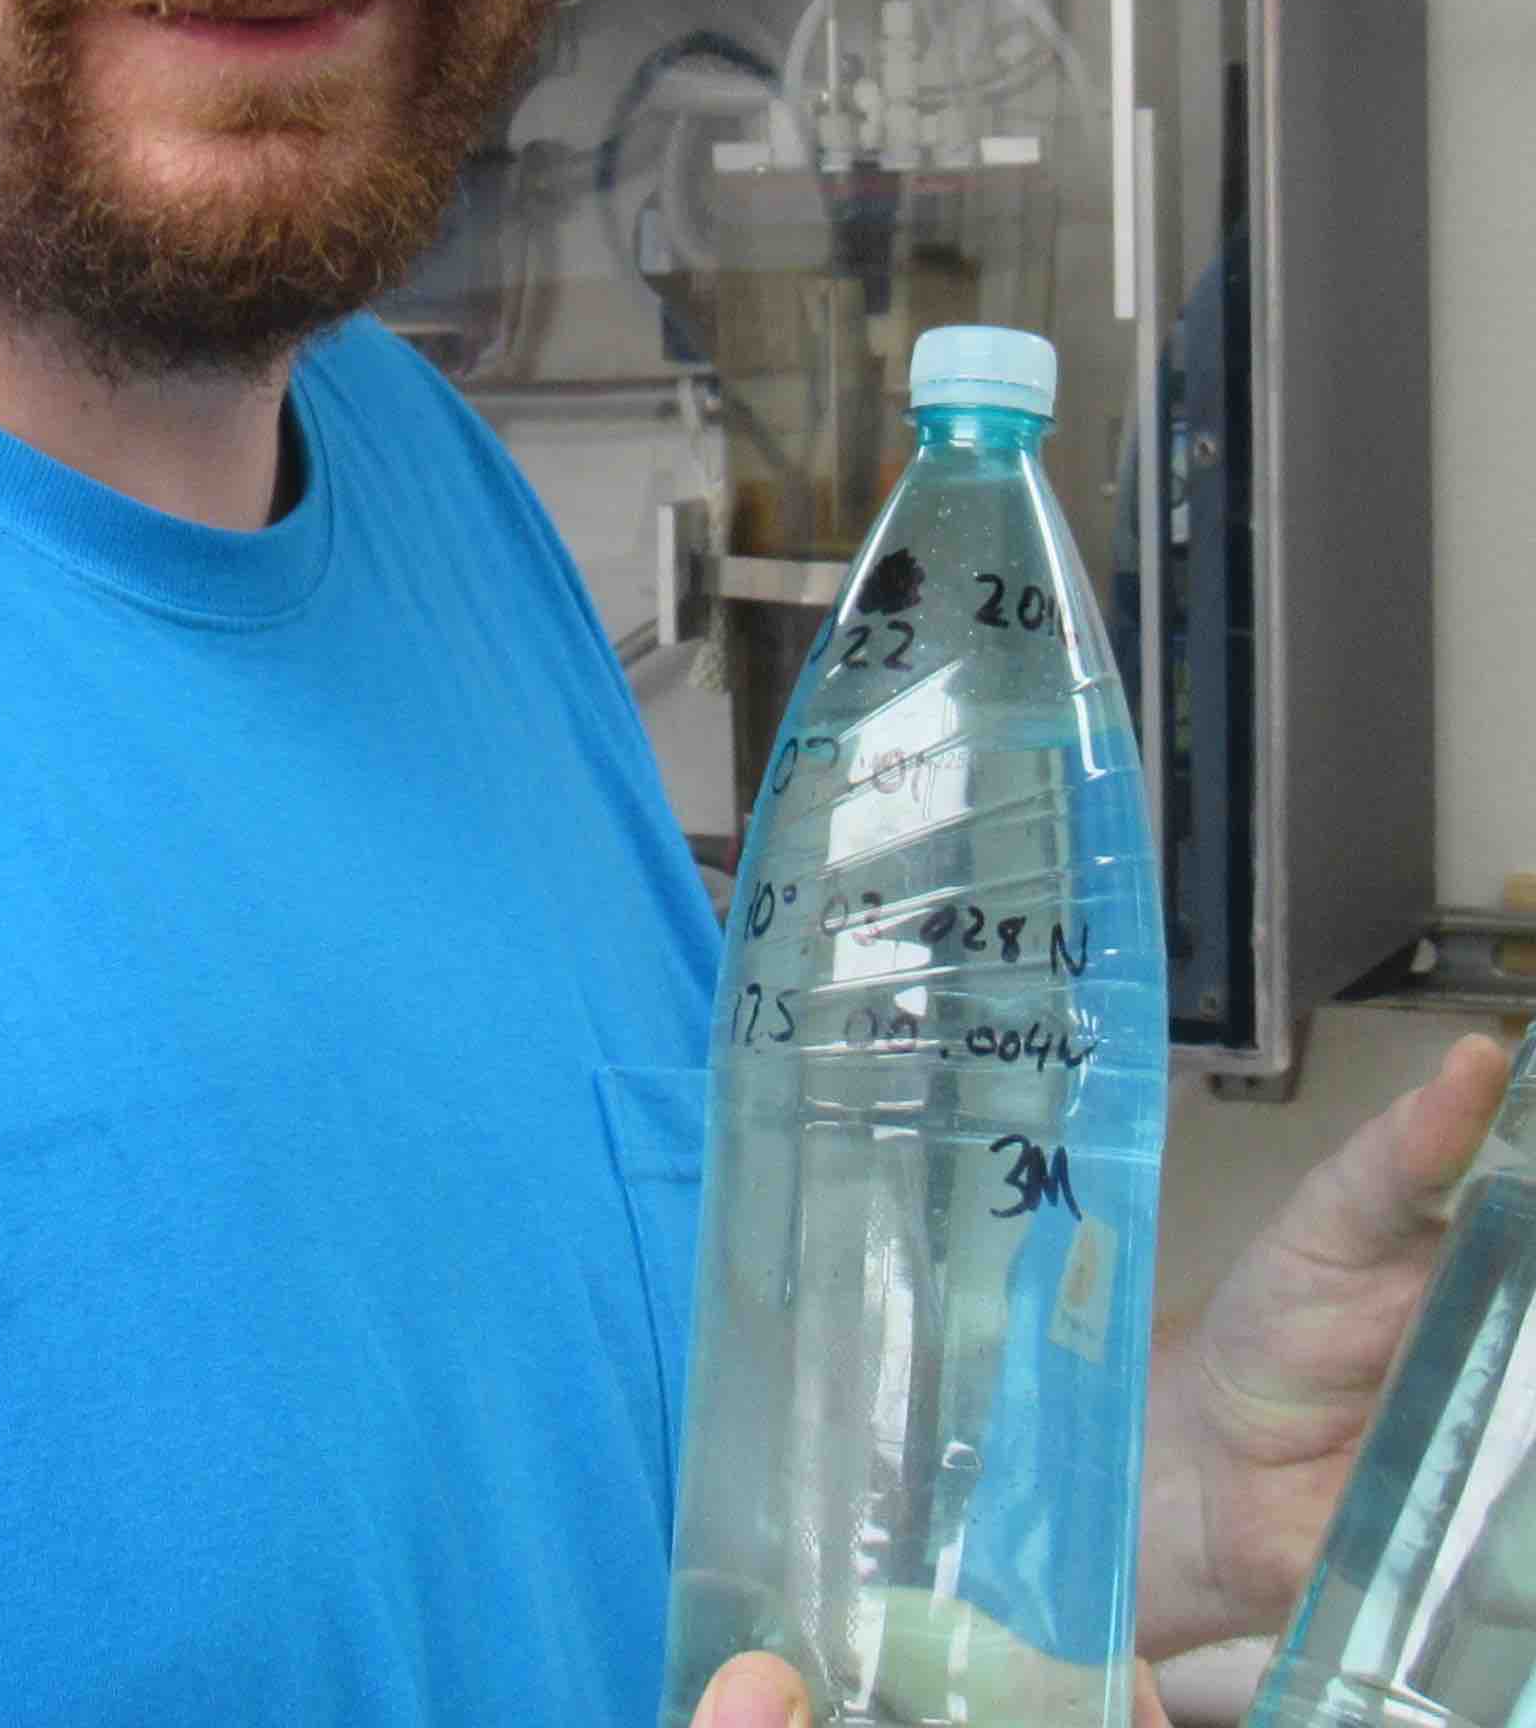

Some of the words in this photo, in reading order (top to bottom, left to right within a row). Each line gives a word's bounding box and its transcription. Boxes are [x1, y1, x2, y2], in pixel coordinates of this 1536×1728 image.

[839, 621, 915, 669] 22
[1049, 920, 1089, 977] N
[988, 1132, 1082, 1222] 3M
